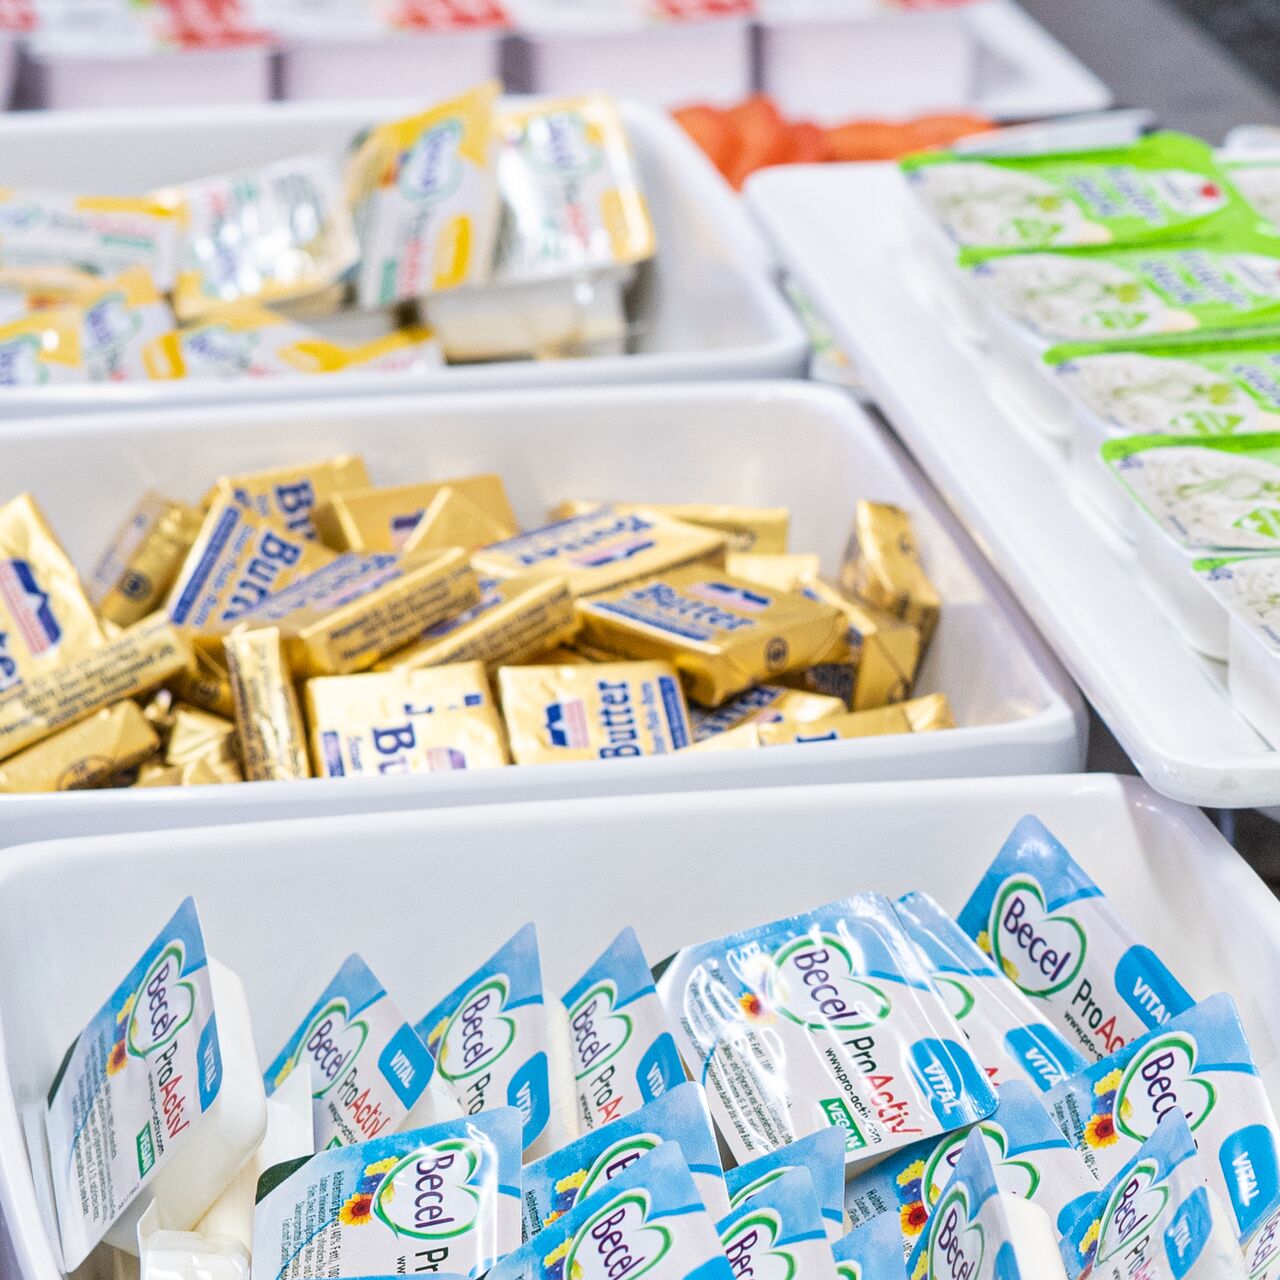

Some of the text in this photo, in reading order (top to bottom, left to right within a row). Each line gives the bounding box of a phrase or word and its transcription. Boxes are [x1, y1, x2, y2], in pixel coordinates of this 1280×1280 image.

[599, 678, 631, 760] Butter
[1003, 896, 1072, 982] Becel
[147, 961, 178, 1043] Becel
[793, 948, 860, 1022] Becel
[1071, 977, 1134, 1054] ProAc
[203, 1039, 217, 1093] VITAL
[306, 1018, 352, 1082] Becel
[461, 993, 494, 1070] Becel
[572, 999, 612, 1069] Becel
[1063, 1010, 1103, 1062] www.pro-
[155, 1039, 191, 1139] ProActiv
[388, 1048, 416, 1090] VITAL
[466, 1071, 491, 1115] Pro
[589, 1064, 625, 1124] ProA
[842, 1035, 923, 1135] ProActiv
[924, 1059, 962, 1115] VITAL
[1024, 1047, 1064, 1087] VITA
[1141, 1051, 1194, 1125] Bec
[336, 1066, 391, 1140] ProActiv
[827, 1101, 863, 1152] VEGAN
[138, 1127, 155, 1175] VEGAN
[414, 1153, 456, 1229] Becel
[1114, 1177, 1149, 1244] Becel
